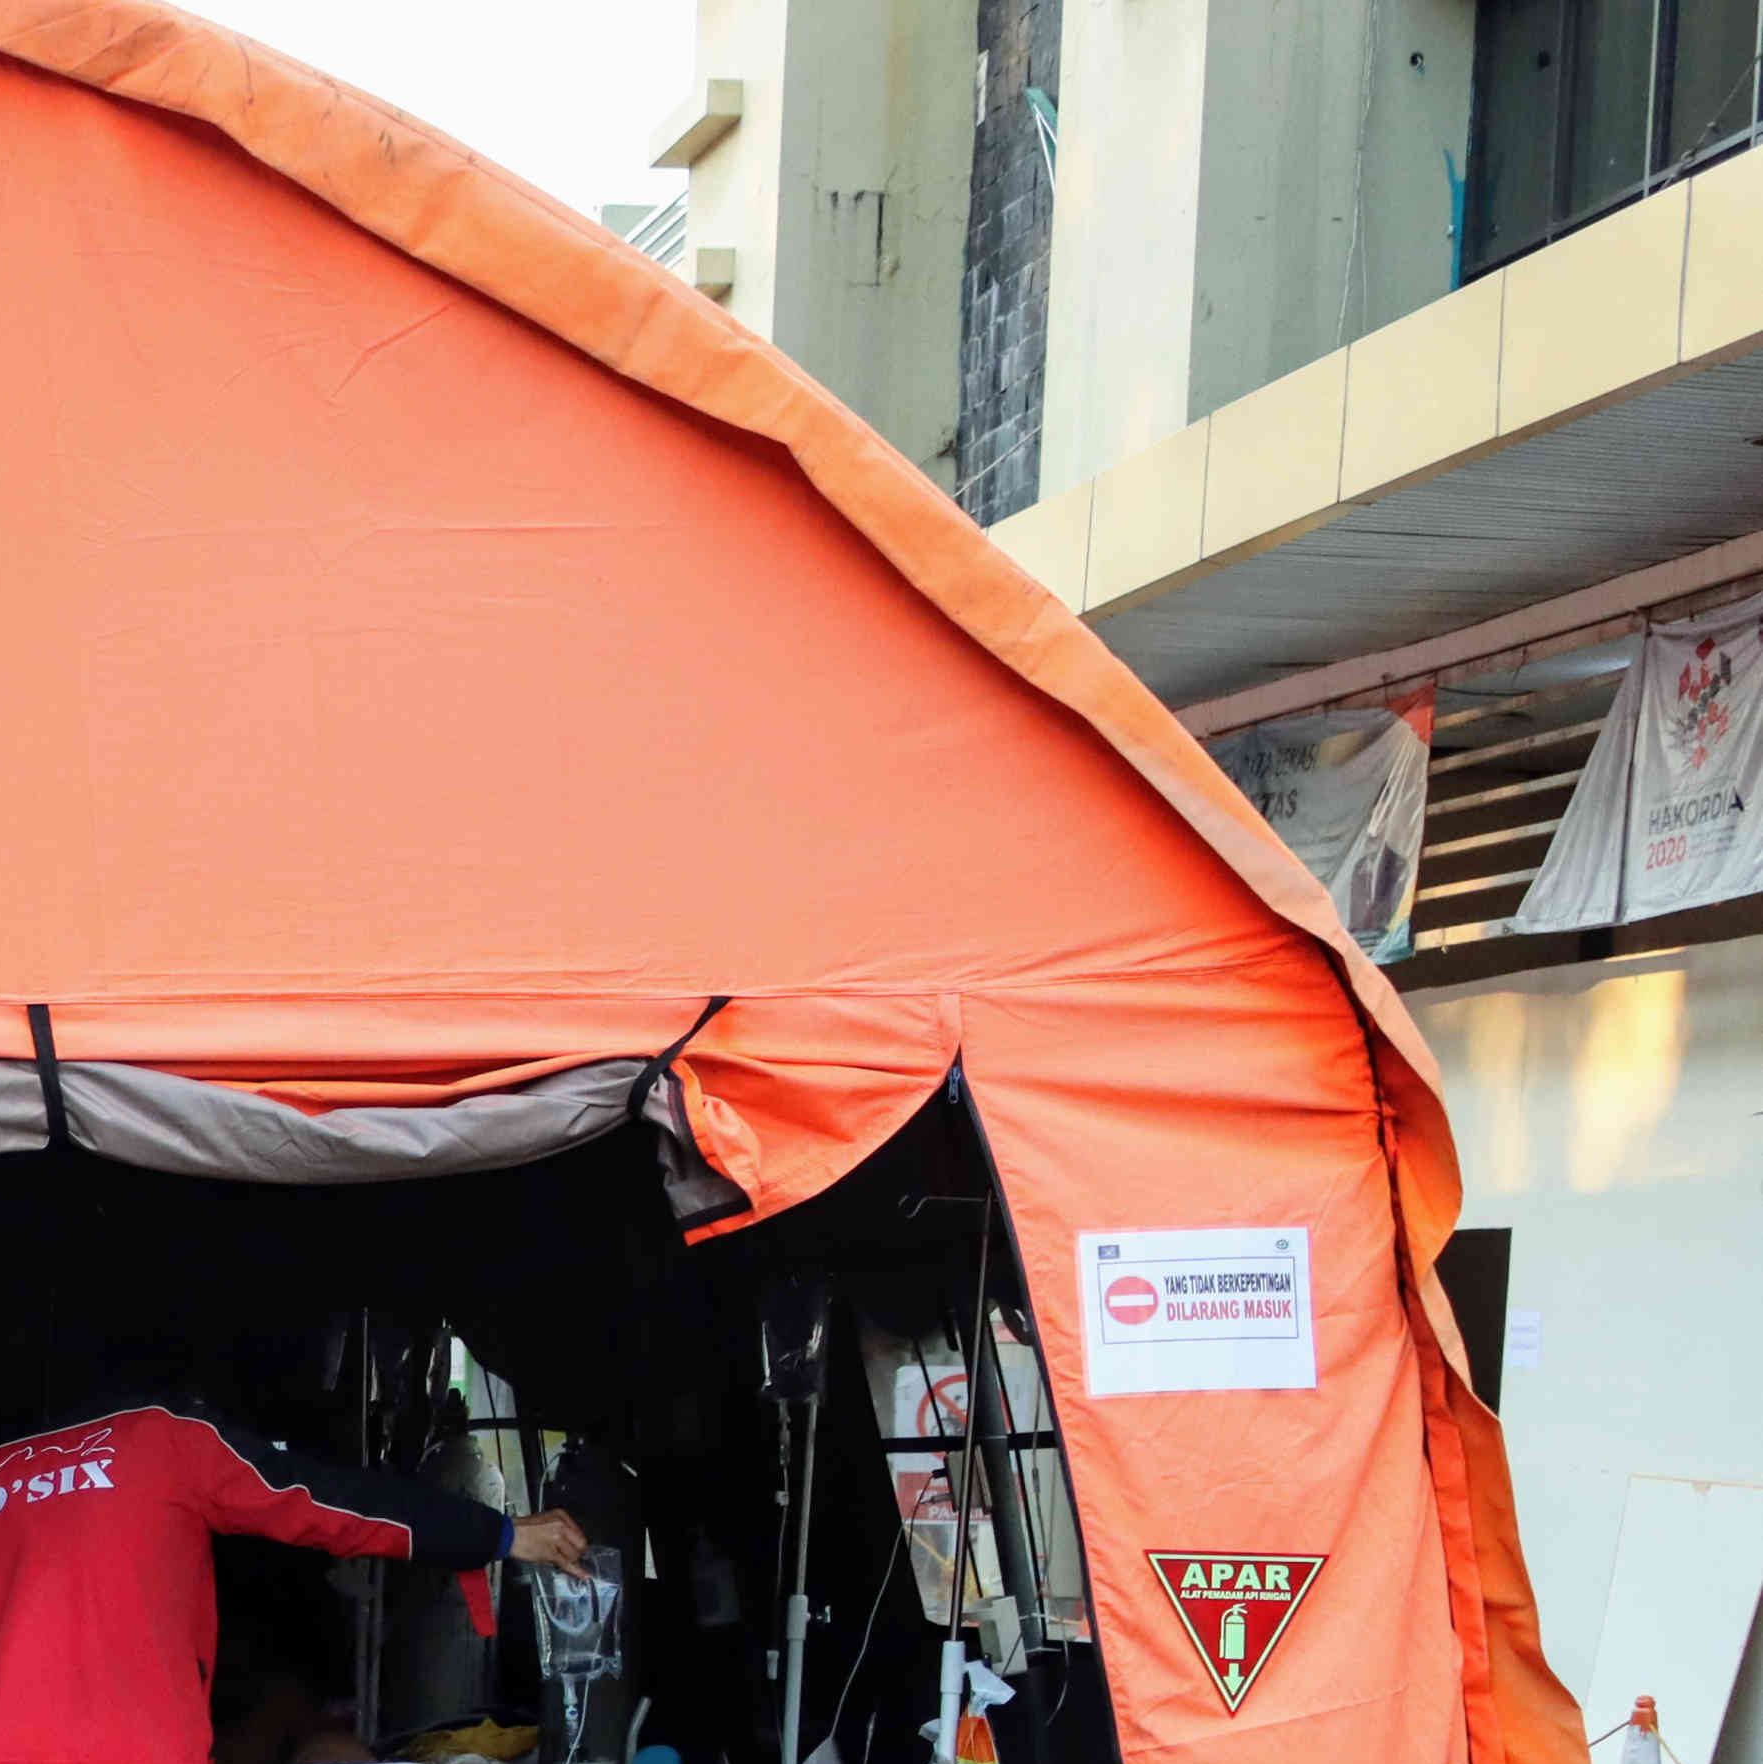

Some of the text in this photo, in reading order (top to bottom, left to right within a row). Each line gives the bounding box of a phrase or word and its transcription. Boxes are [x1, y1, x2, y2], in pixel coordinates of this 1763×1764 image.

[1648, 786, 1744, 837] HAKORDIA
[1646, 834, 1687, 870] 2020
[1163, 1272, 1291, 1296] YANG TIDAK BERKEPENTINGAN
[1166, 1299, 1292, 1322] DILARANG MASUK
[1180, 1562, 1291, 1591] APAR
